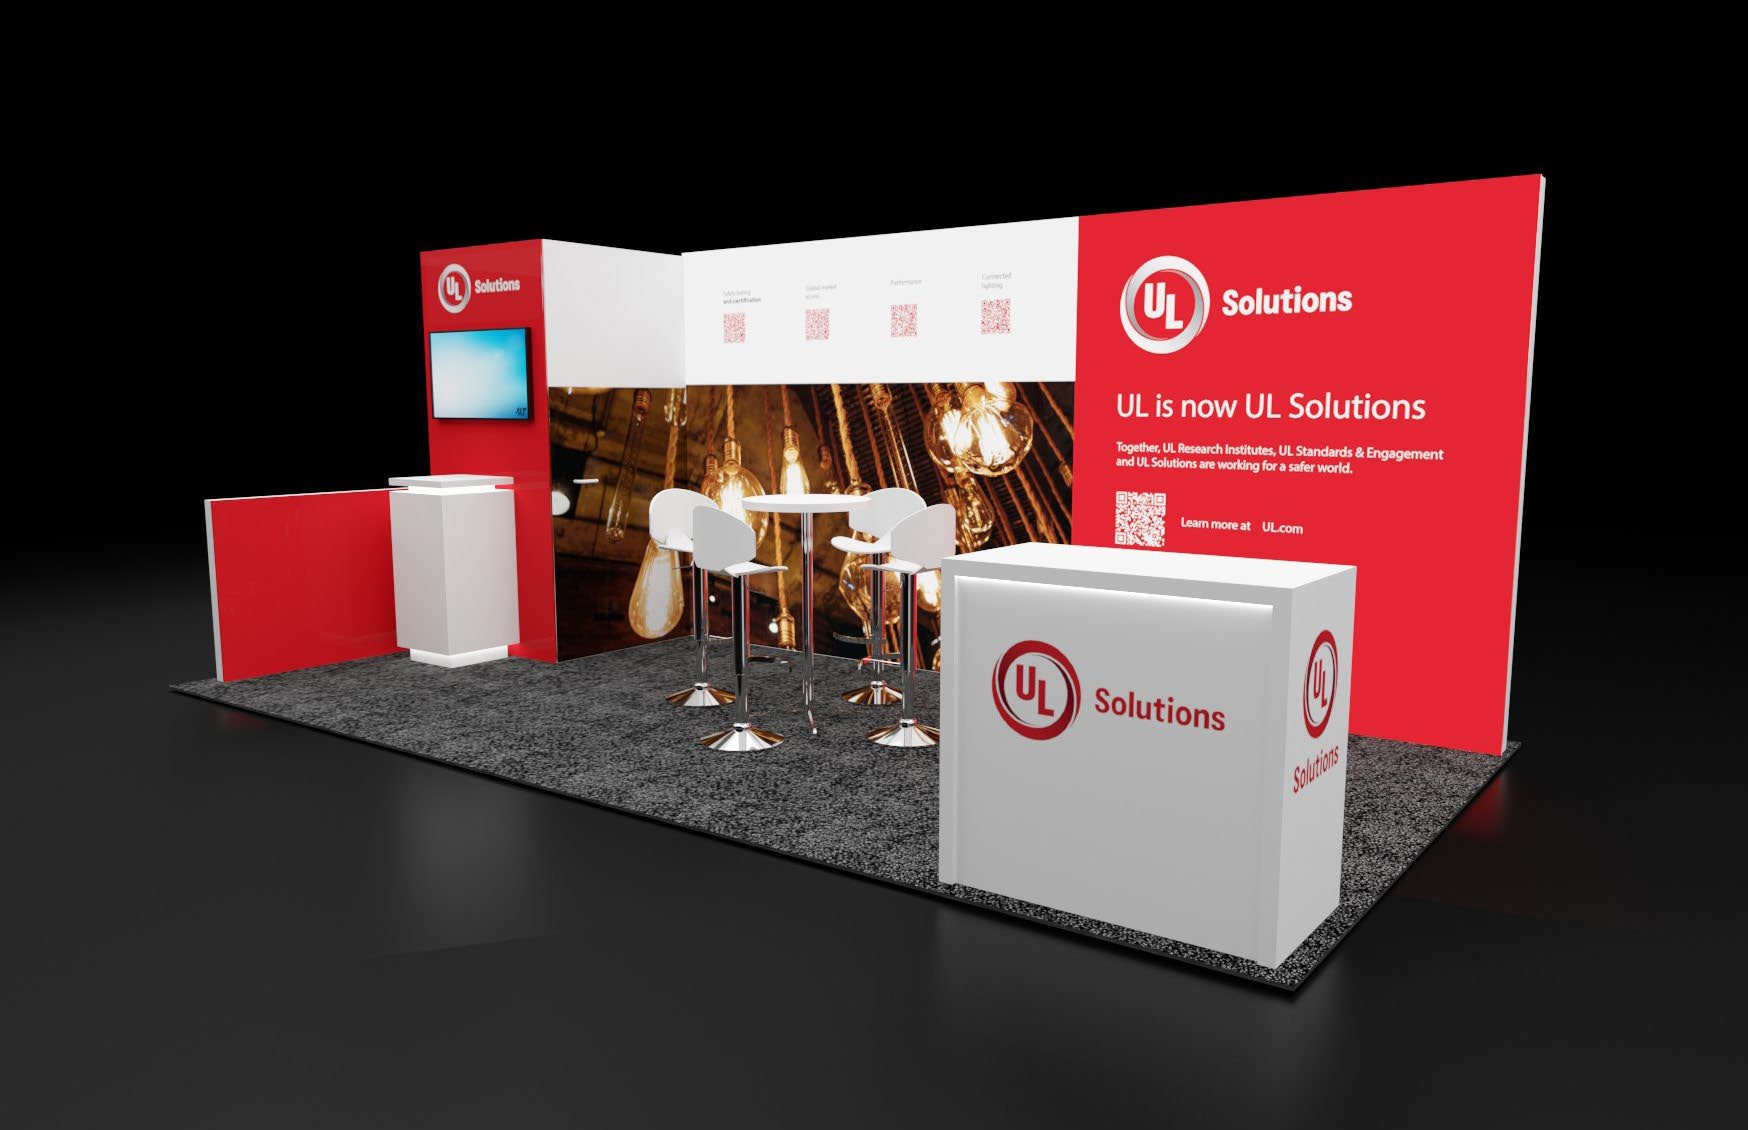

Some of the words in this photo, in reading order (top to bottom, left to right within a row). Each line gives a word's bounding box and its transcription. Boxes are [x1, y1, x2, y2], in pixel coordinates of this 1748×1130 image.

[446, 276, 462, 301] UL
[474, 277, 521, 294] Solutions
[1143, 281, 1184, 330] UL
[1221, 285, 1353, 317] Solutions
[1117, 393, 1149, 418] UL
[1155, 394, 1174, 418] is
[1180, 399, 1238, 419] now
[1245, 393, 1282, 419] UL
[1288, 392, 1426, 420] Solutions
[1115, 456, 1135, 467] and
[1136, 456, 1150, 468] UL
[1151, 457, 1197, 470] Solutions
[1199, 460, 1215, 470] are
[1217, 459, 1260, 473] working
[1261, 460, 1278, 472] for
[1279, 462, 1286, 472] a
[1288, 461, 1315, 473] safer
[1317, 462, 1353, 474] world.
[1116, 441, 1161, 455] Together,
[1162, 442, 1176, 454] UL
[1178, 443, 1223, 455] Research
[1225, 444, 1277, 457] Institutes,
[1279, 445, 1294, 457] UL
[1295, 445, 1353, 458] Standards
[1355, 447, 1365, 459] &
[1366, 447, 1444, 462] Engagement
[1180, 516, 1209, 530] Learn
[1211, 519, 1239, 531] more
[1240, 520, 1251, 532] at
[1262, 521, 1304, 535] UL.com
[1015, 663, 1055, 717] UL
[1094, 687, 1226, 732] Solutions
[1313, 659, 1328, 709] UL
[1293, 745, 1339, 794] Solutions
